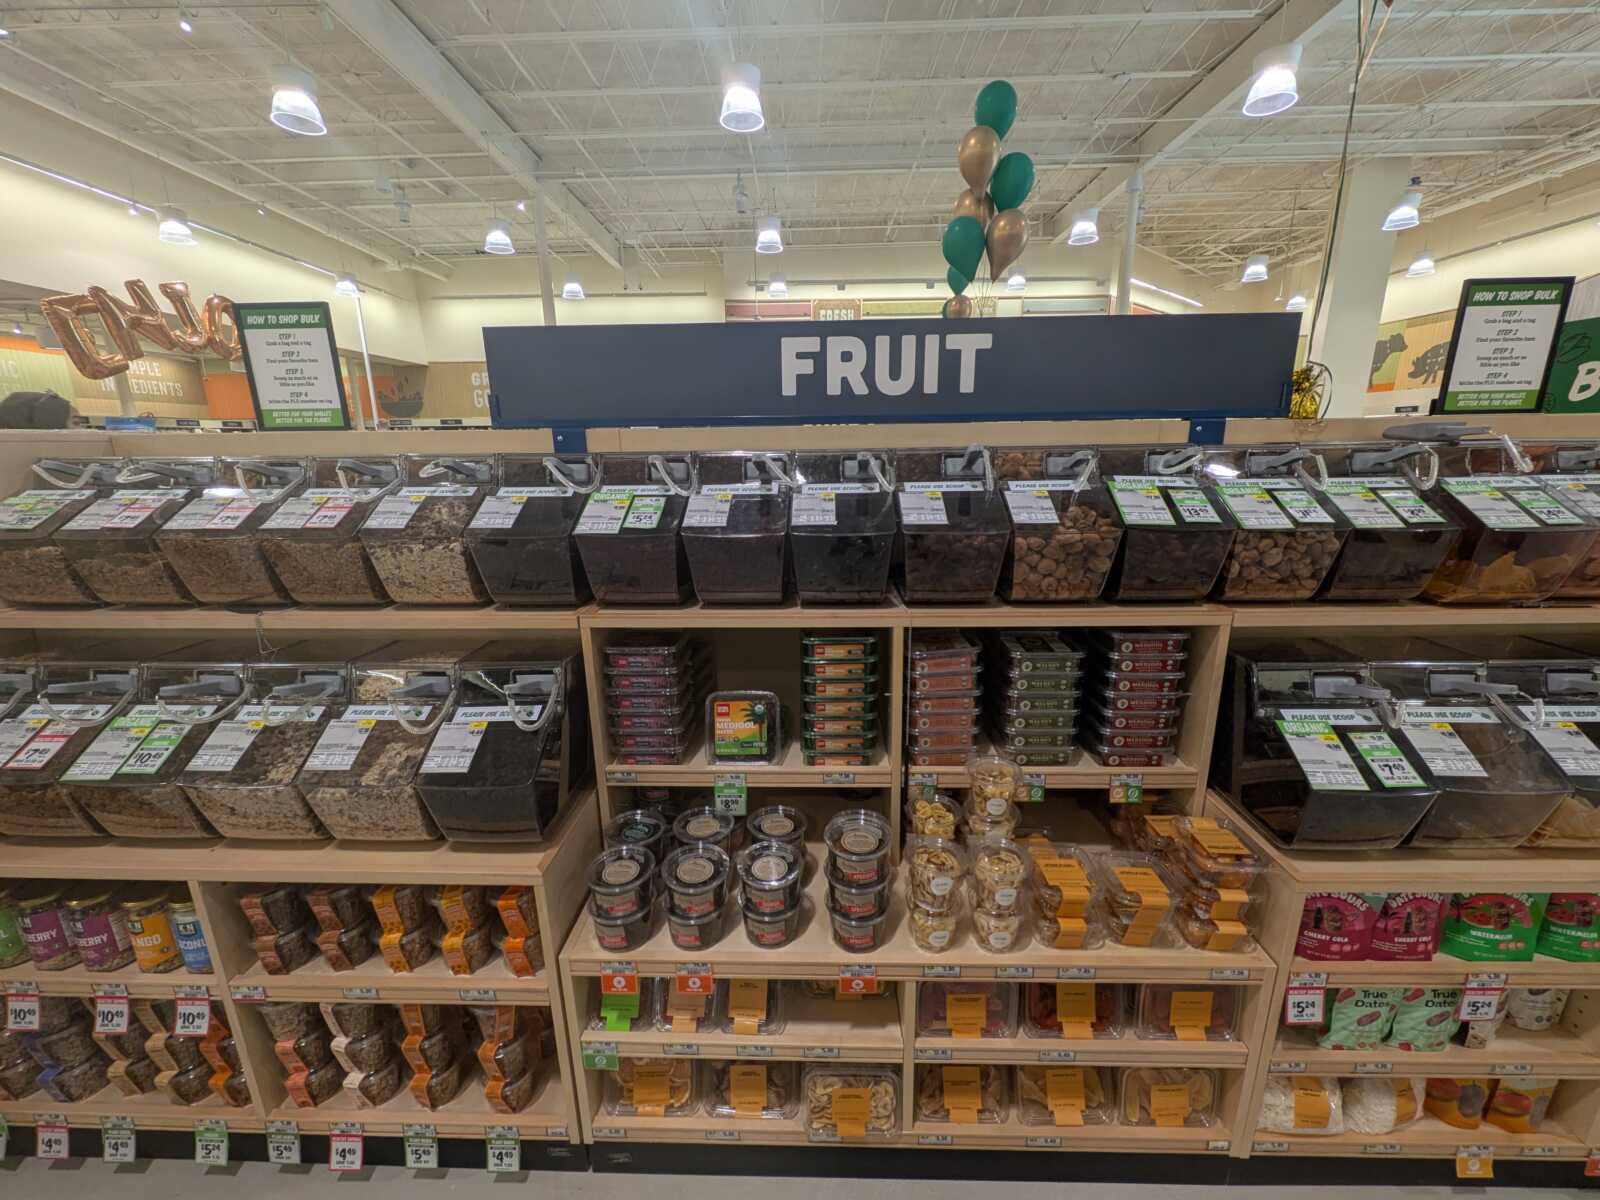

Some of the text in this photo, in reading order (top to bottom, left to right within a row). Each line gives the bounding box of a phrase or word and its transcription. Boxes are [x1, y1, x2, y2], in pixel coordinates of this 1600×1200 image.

[1473, 289, 1559, 302] HOW TO SHOP BULK
[247, 313, 320, 325] HOW TO SHOP BULK
[780, 333, 993, 396] FRUIT
[1361, 989, 1388, 999] True
[1432, 989, 1458, 999] True
